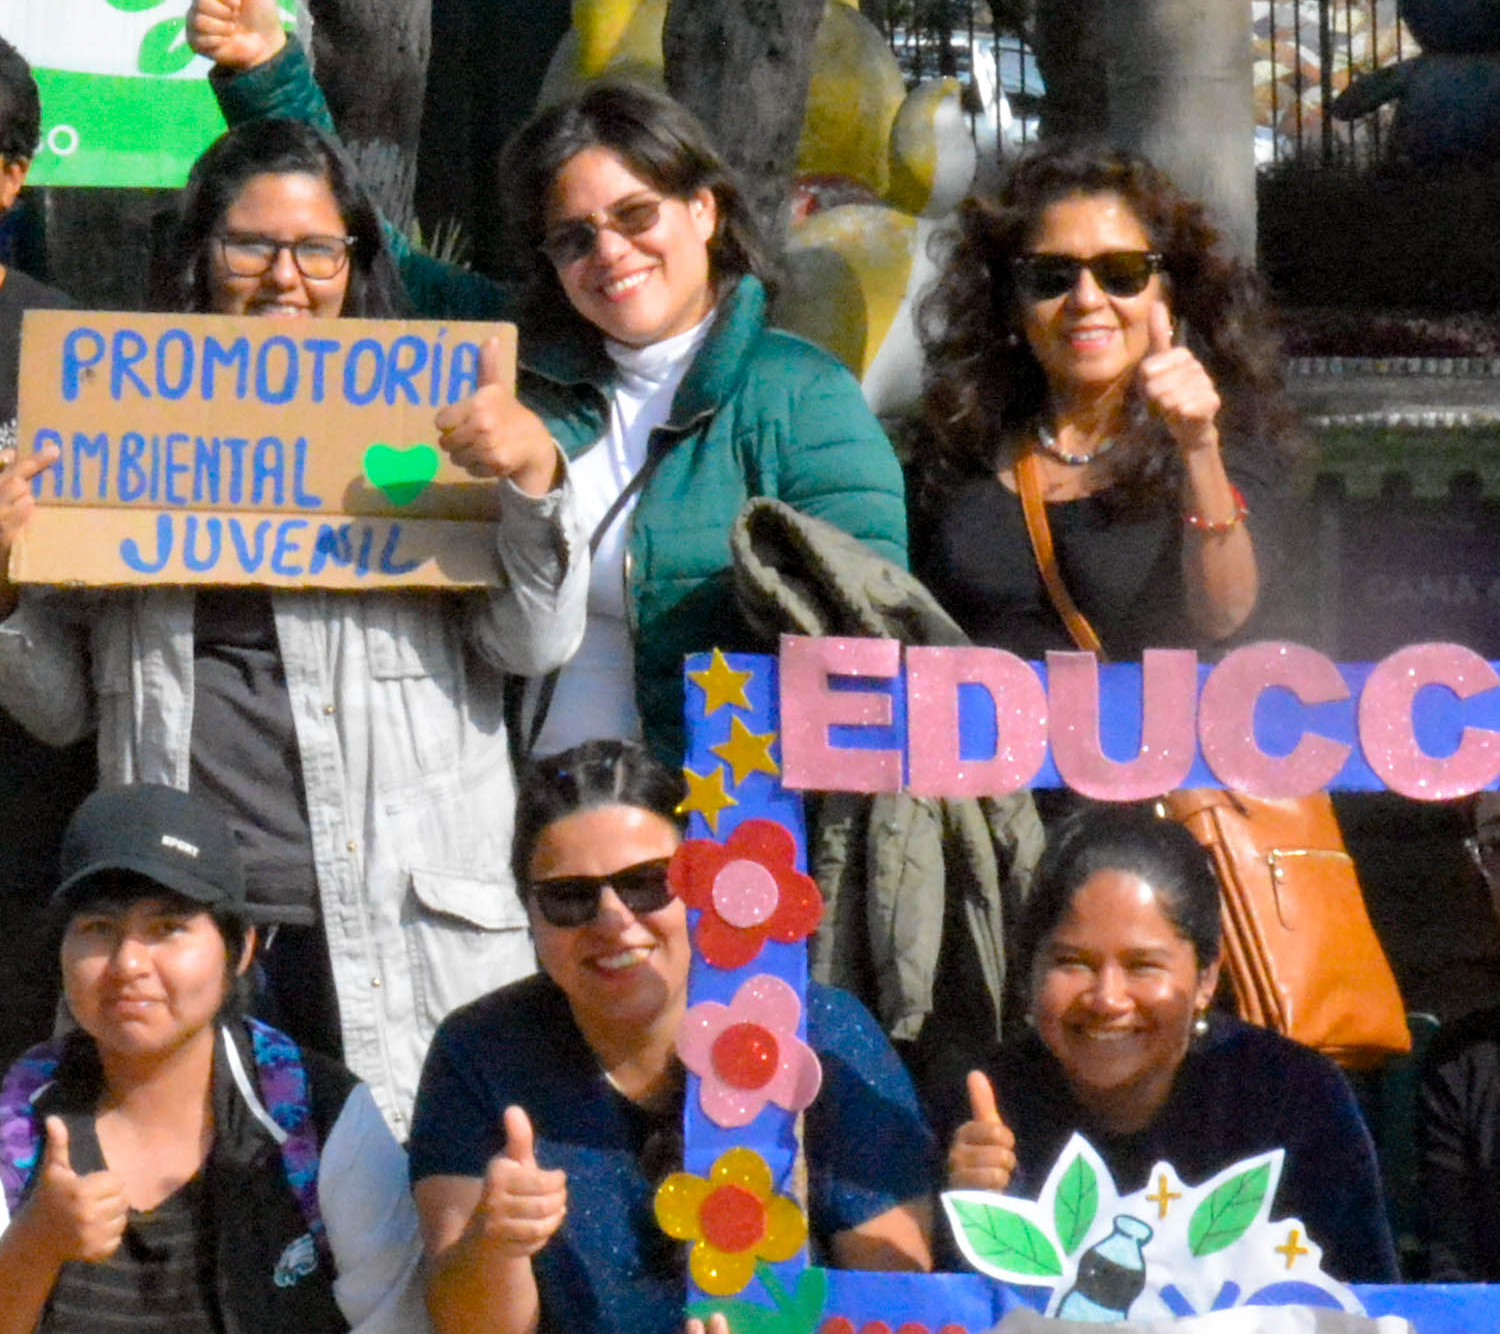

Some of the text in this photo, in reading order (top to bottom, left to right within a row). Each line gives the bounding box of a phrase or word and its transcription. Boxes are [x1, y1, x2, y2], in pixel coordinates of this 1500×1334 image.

[61, 327, 482, 407] PROMOTORÍA
[31, 427, 322, 508] AMBIENTAL
[120, 513, 421, 578] JUVENIL
